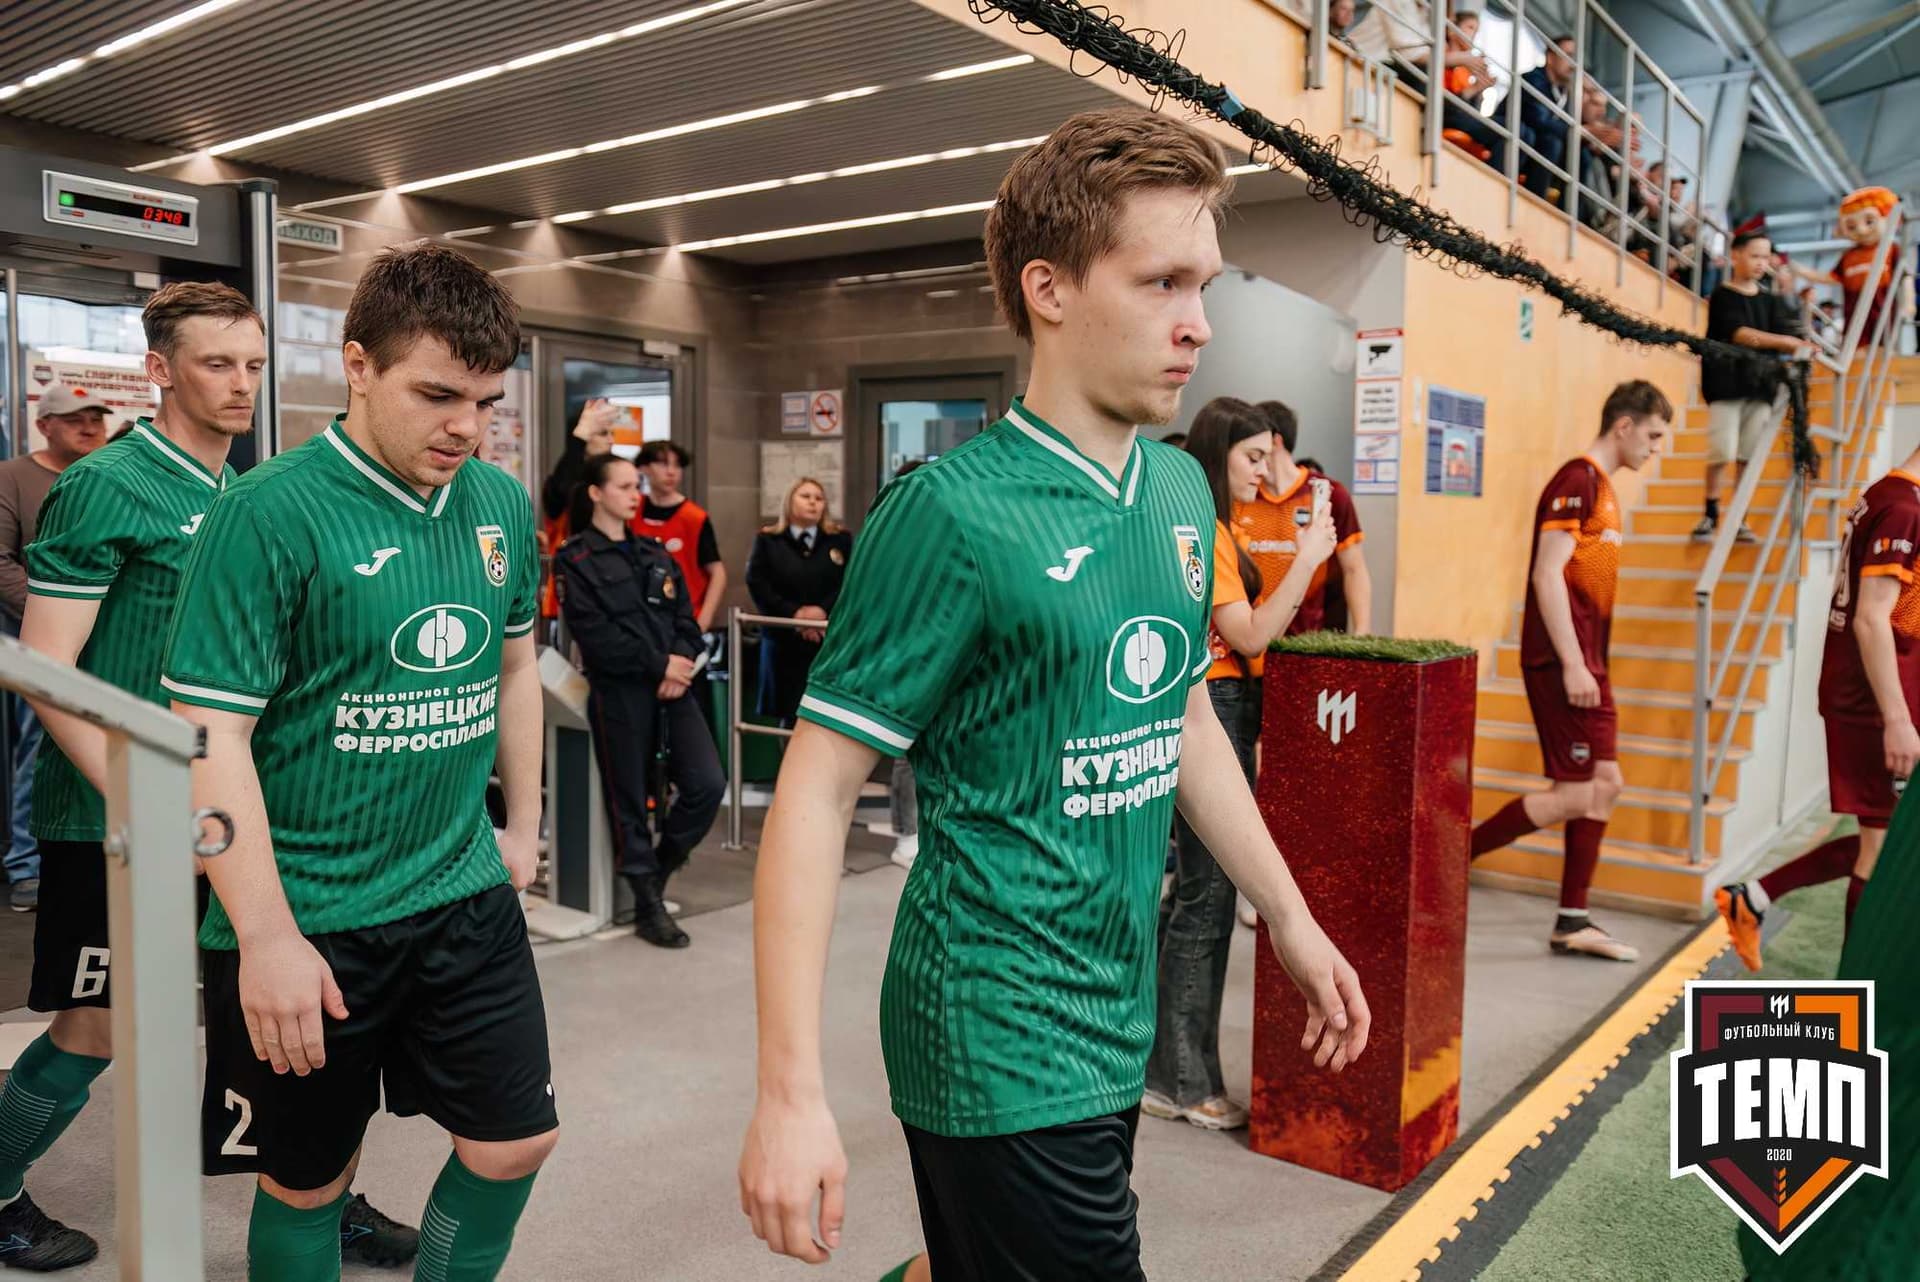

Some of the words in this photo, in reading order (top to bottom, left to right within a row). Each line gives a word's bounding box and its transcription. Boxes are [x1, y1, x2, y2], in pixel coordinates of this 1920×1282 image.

[143, 207, 183, 226] 0348
[334, 686, 498, 730] КУЗНЕЦКИЕ
[340, 687, 450, 704] АКЦИОНЕРНОЕ
[333, 713, 496, 754] ФЕРРОСПЛАВЫ
[1061, 733, 1182, 787] КУЗНЕЦК
[1062, 766, 1180, 819] ФЕРРОПЛА
[71, 946, 111, 998] 6
[220, 1087, 258, 1156] 2
